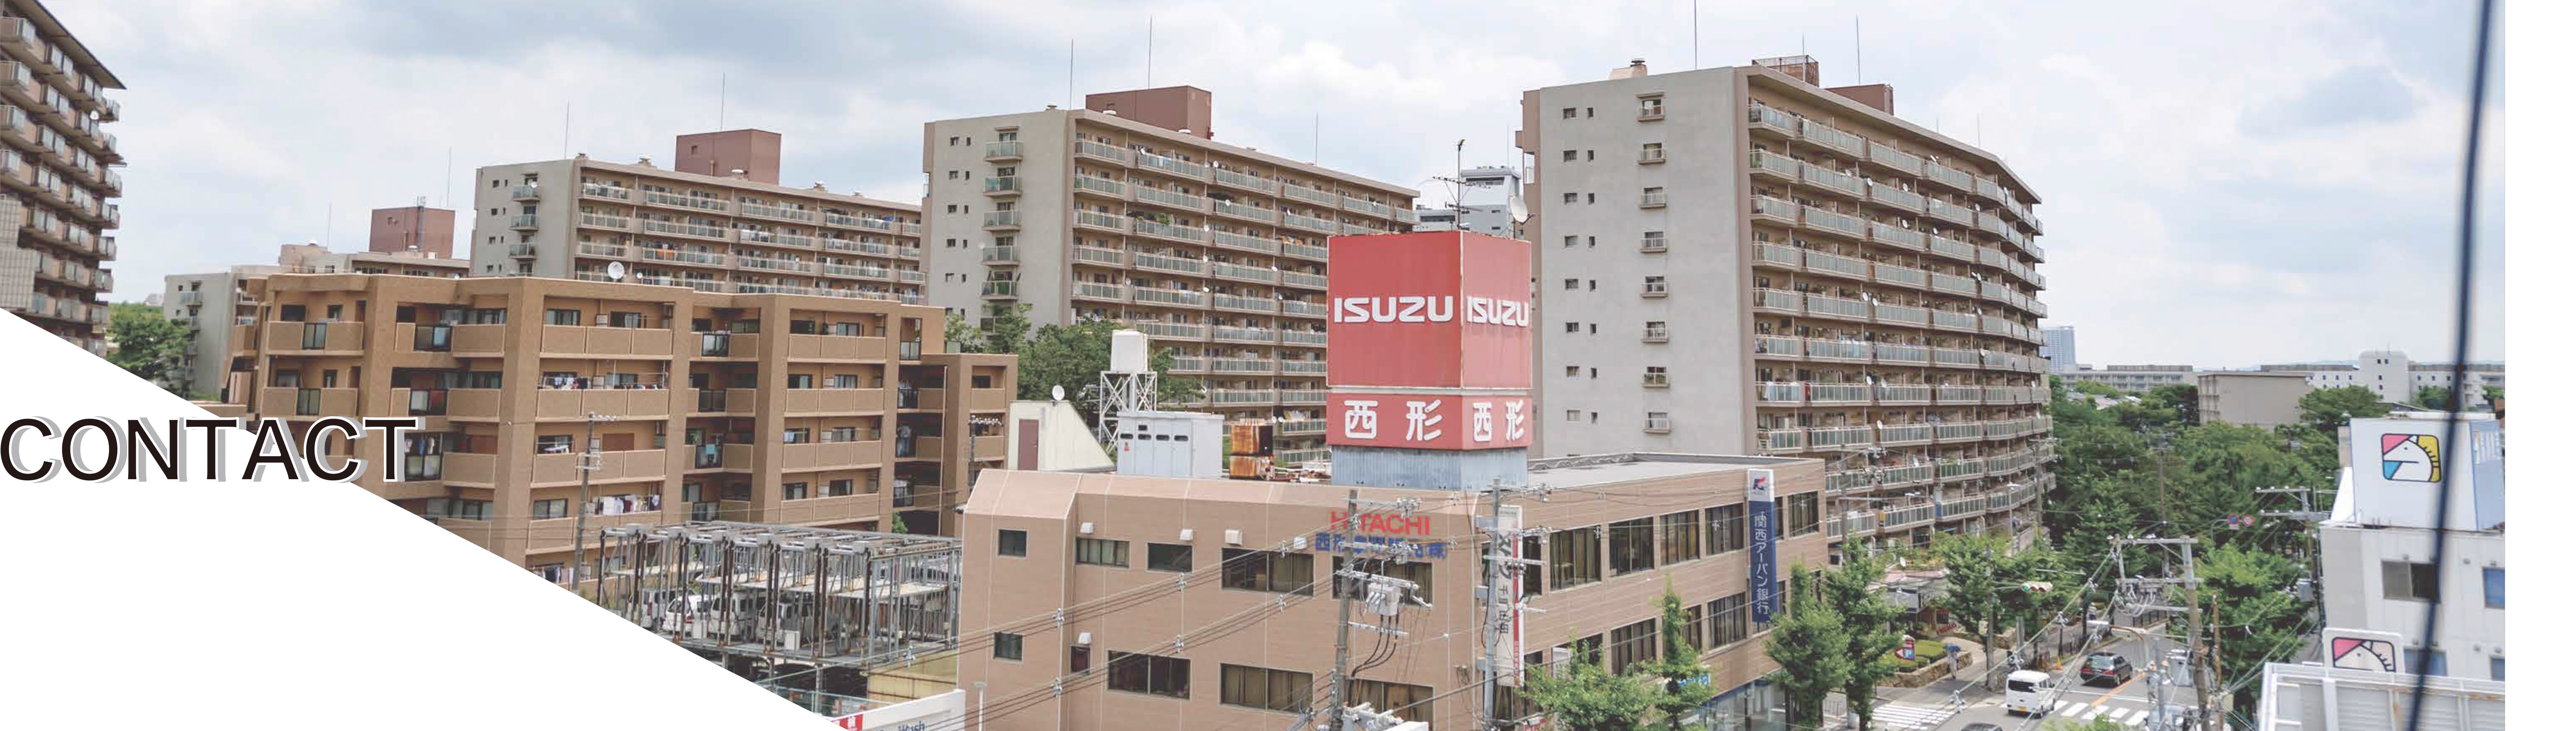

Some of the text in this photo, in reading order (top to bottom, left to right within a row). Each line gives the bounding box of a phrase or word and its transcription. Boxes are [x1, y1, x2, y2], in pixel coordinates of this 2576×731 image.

[1334, 296, 1453, 323] ISUZU
[1467, 296, 1529, 327] ISUZU
[1344, 400, 1442, 441] 西形
[1473, 400, 1524, 442] 西形
[1330, 511, 1431, 536] HTACHI
[1754, 514, 1769, 615] 関西アーバン銀行
